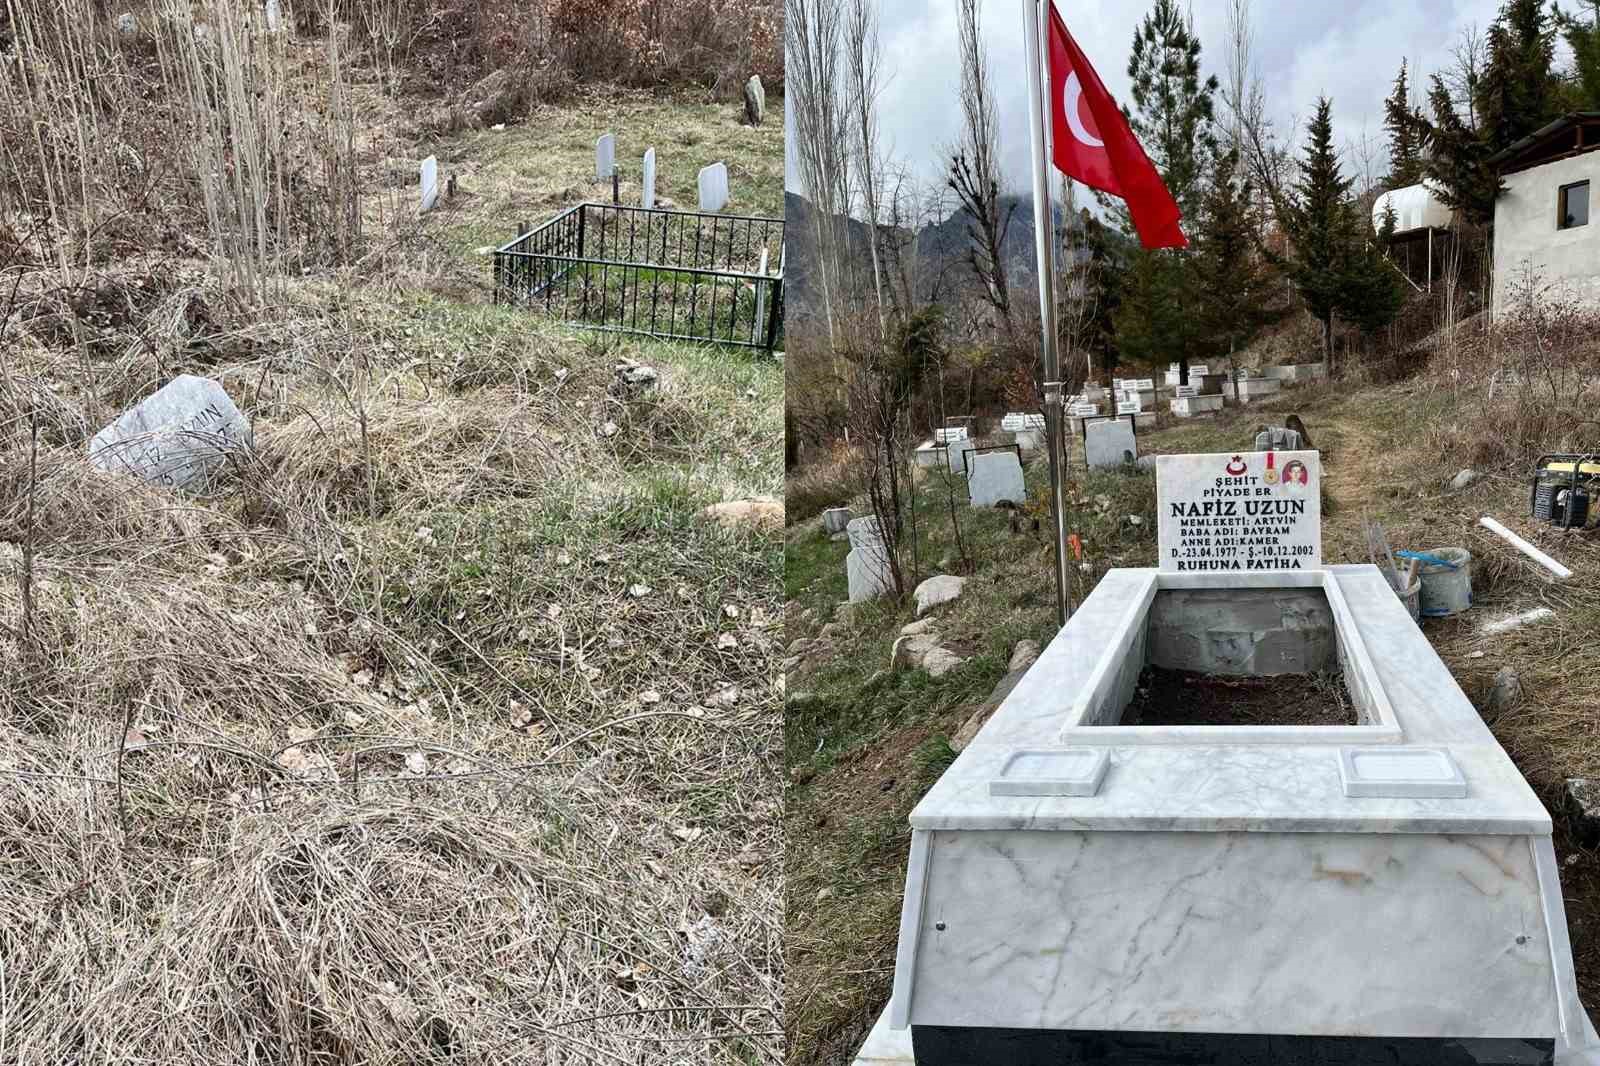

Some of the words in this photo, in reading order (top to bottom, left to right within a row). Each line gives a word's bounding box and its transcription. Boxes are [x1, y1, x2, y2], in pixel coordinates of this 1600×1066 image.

[1216, 476, 1258, 487] ŞEHİT
[1204, 487, 1250, 497] PİYADE
[1256, 487, 1271, 496] ER
[1171, 499, 1236, 517] NAFİZ
[1245, 499, 1305, 515] UZUN
[1181, 517, 1249, 526] MEMLEKETİ:
[1255, 516, 1296, 525] ARTVİN
[1244, 527, 1290, 535] BAYRAM
[1178, 560, 1240, 570] RUHUNA
[1247, 558, 1301, 569] FATİHA
